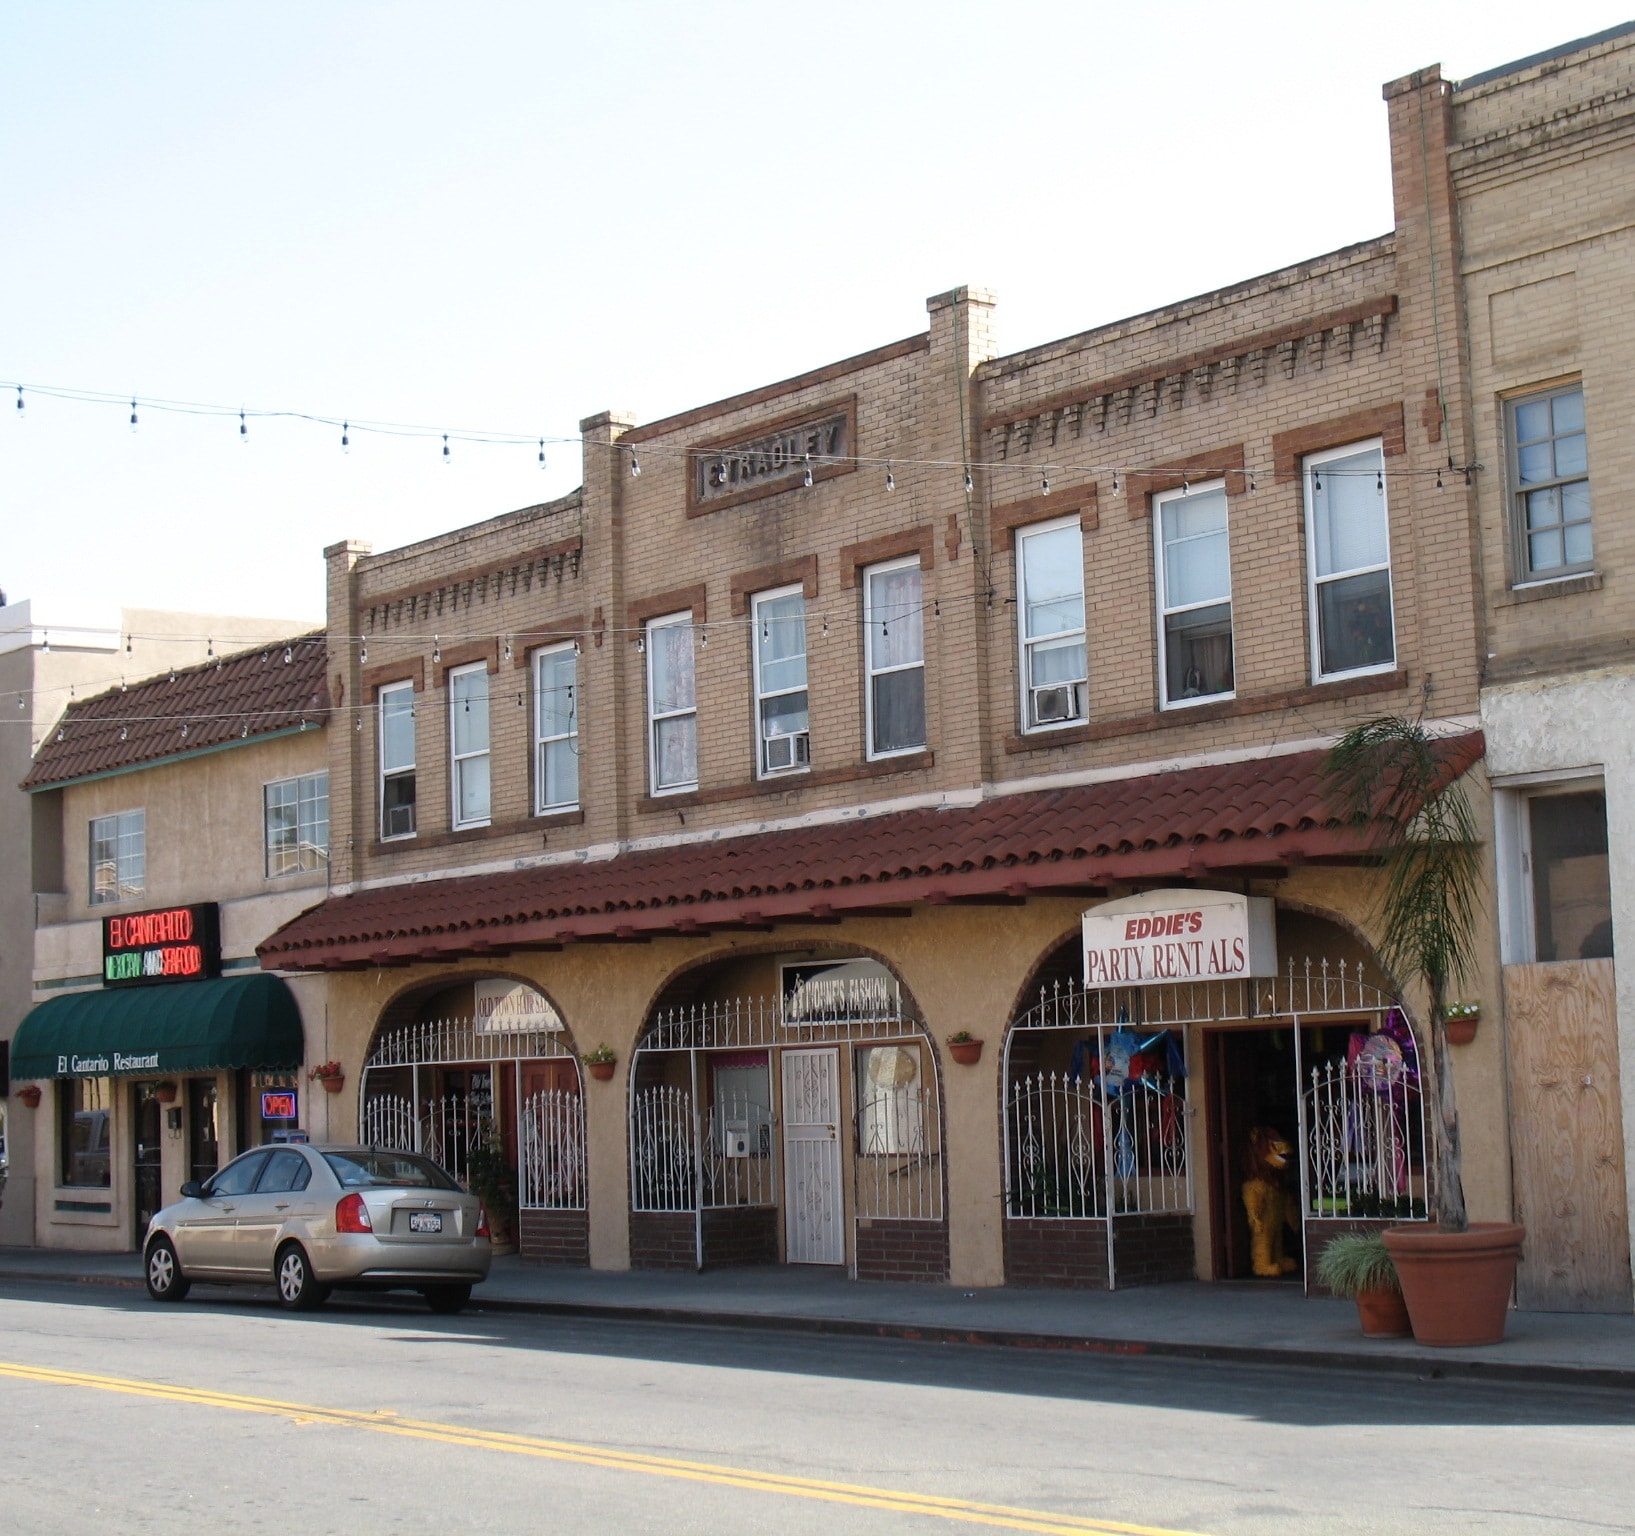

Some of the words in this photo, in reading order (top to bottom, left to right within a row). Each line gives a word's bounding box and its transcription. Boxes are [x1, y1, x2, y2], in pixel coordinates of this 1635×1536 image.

[124, 909, 193, 946] CANTARITO
[1124, 911, 1203, 941] EDDIE'S
[106, 952, 142, 980] MEXICAN
[142, 949, 163, 976] AND
[161, 945, 202, 976] SEAFOOD
[1087, 946, 1145, 983] PARTY
[1152, 937, 1245, 978] RENTALS
[479, 997, 494, 1018] OLD
[494, 995, 514, 1017] TOWN
[516, 994, 534, 1015] HAIR
[849, 978, 887, 1010] FASHION
[57, 1055, 68, 1073] El
[71, 1053, 109, 1073] Cantarito
[113, 1051, 159, 1070] Restaurant
[265, 1095, 293, 1116] OPEN
